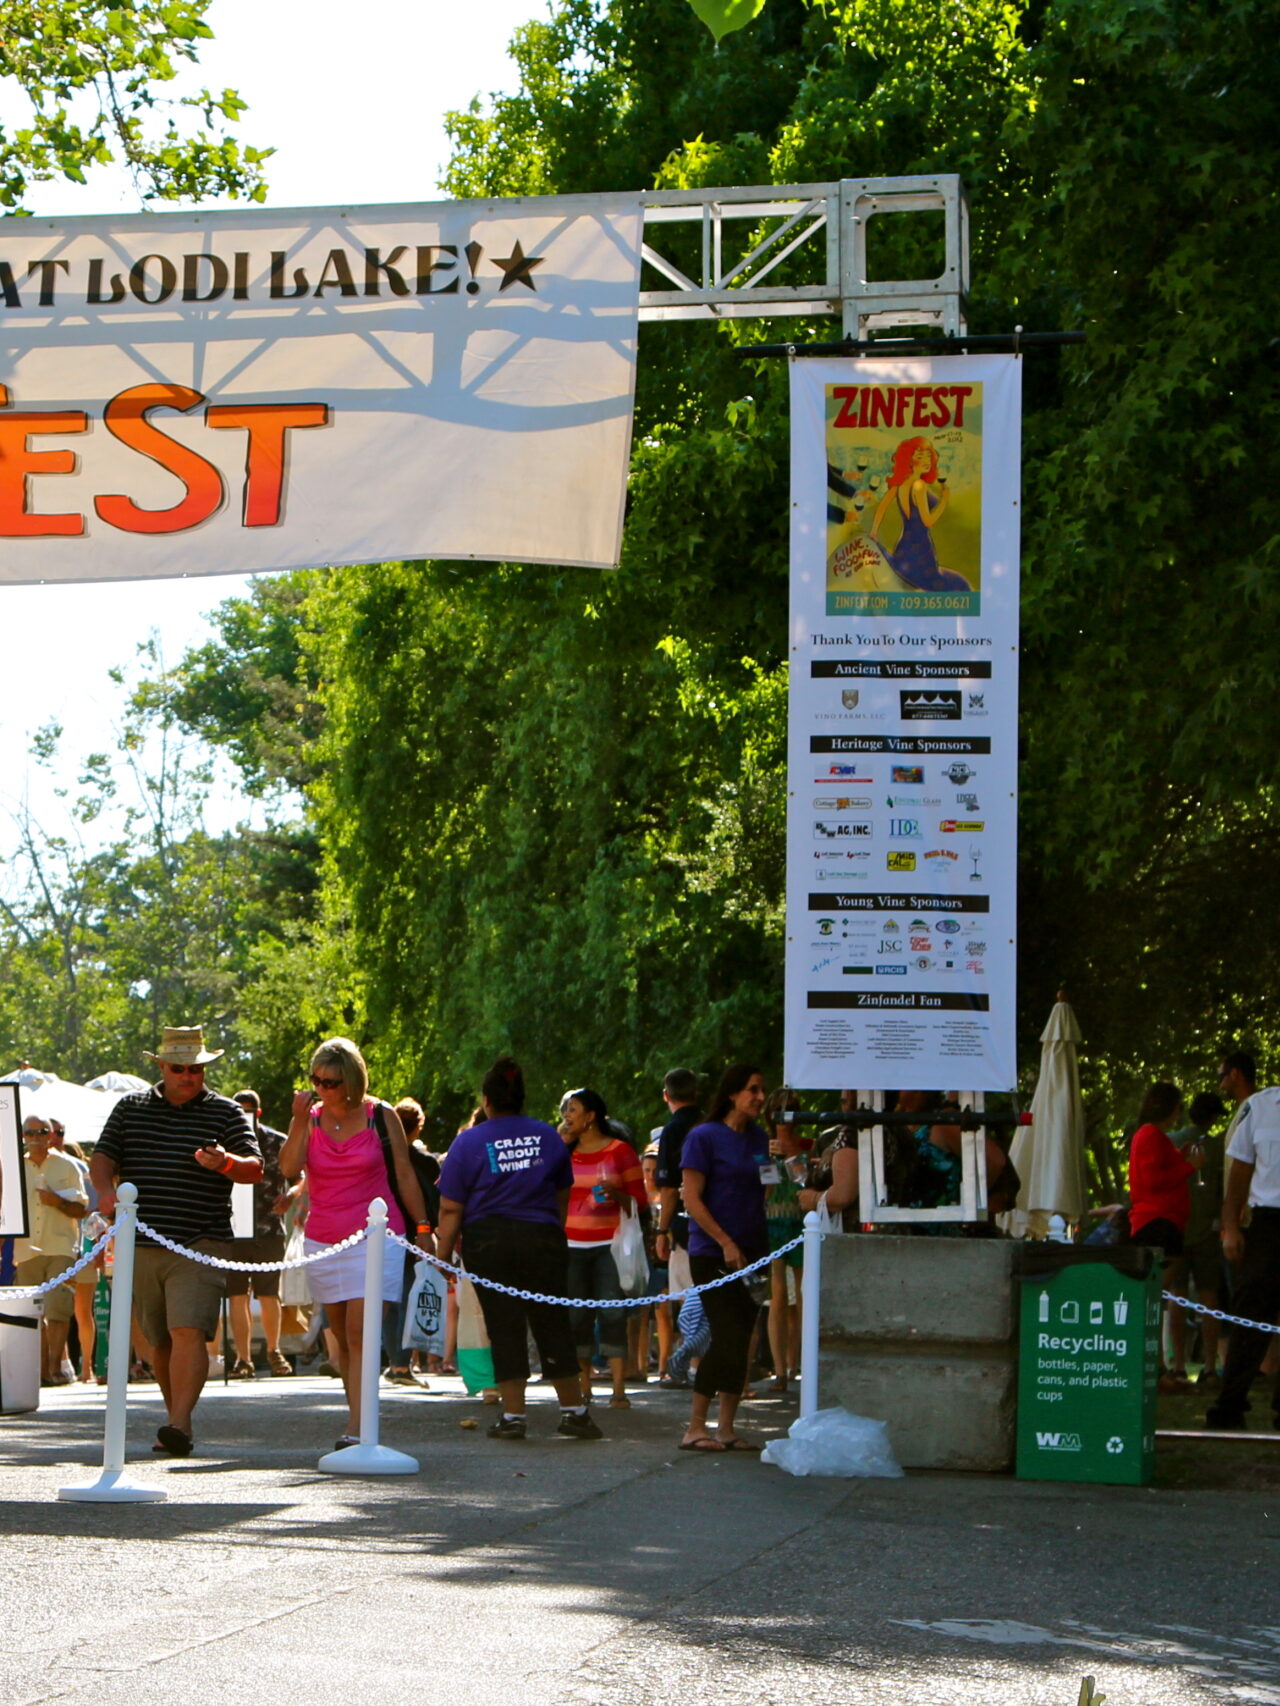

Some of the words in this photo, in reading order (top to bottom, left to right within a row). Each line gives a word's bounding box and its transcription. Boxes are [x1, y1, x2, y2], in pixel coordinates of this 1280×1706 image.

[86, 251, 251, 305] LODI
[269, 240, 484, 299] LAKE!
[833, 386, 973, 429] ZINFEST
[811, 634, 852, 646] Thank
[857, 634, 881, 646] You
[881, 634, 895, 646] To
[899, 634, 927, 646] Our
[930, 634, 993, 650] Sponsors
[835, 663, 882, 675] Ancient
[886, 663, 911, 675] Vine
[915, 663, 970, 677] Sponsors
[831, 738, 884, 752] Heritage
[888, 739, 914, 751] Vine
[917, 739, 972, 754] Sponsors
[835, 896, 874, 909] Young
[877, 896, 905, 908] Vine
[910, 896, 963, 911] Sponsors
[857, 994, 915, 1008] Zinfandel
[920, 995, 942, 1006] Fan
[494, 1136, 541, 1149] CRAZY
[497, 1147, 541, 1161] ABOUT
[498, 1159, 531, 1173] WINE
[1038, 1333, 1127, 1356] Recycling
[1037, 1358, 1080, 1372] bottles,
[1083, 1361, 1118, 1373] paper,
[1037, 1376, 1066, 1388] cans,
[1068, 1375, 1089, 1386] and
[1092, 1376, 1128, 1388] plastic
[1037, 1389, 1063, 1403] cups
